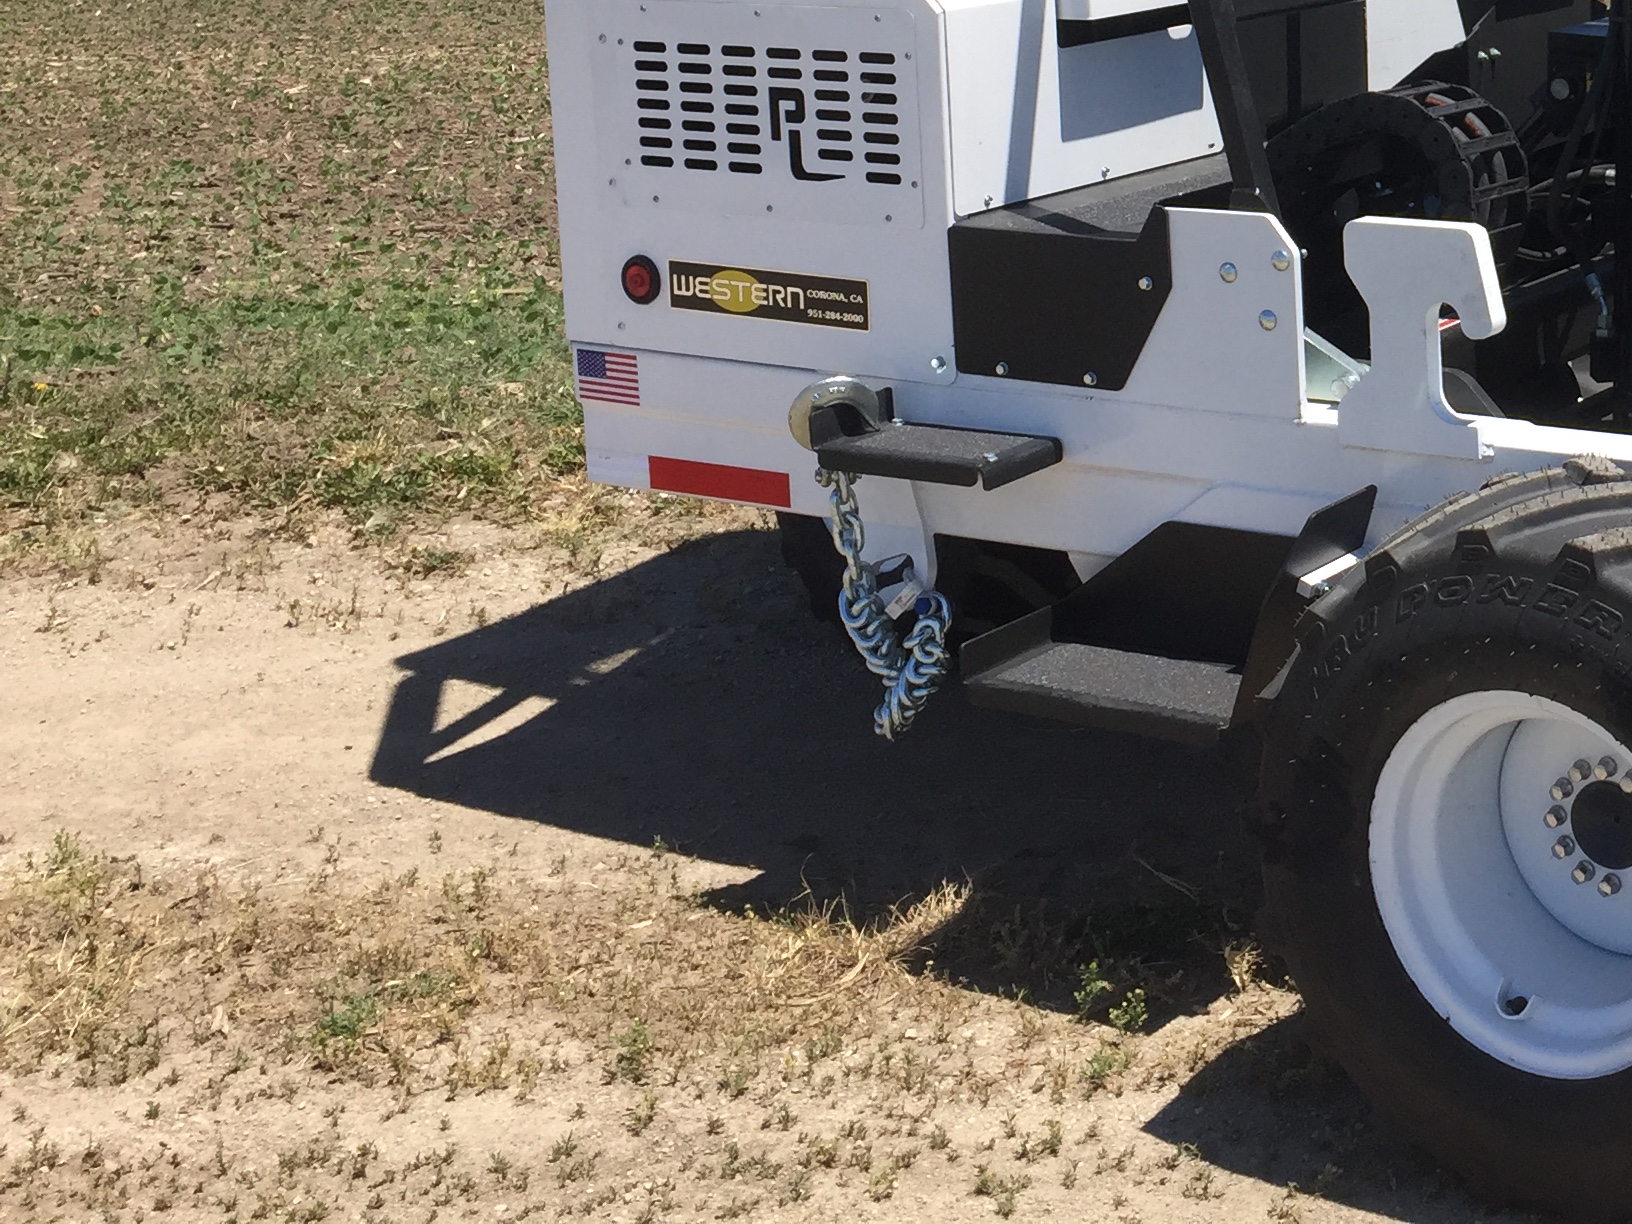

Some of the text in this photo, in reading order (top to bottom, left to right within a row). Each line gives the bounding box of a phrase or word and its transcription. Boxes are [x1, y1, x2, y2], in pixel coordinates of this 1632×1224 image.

[672, 273, 805, 310] WESTERN
[850, 294, 864, 304] CA
[1396, 574, 1625, 640] POWER
